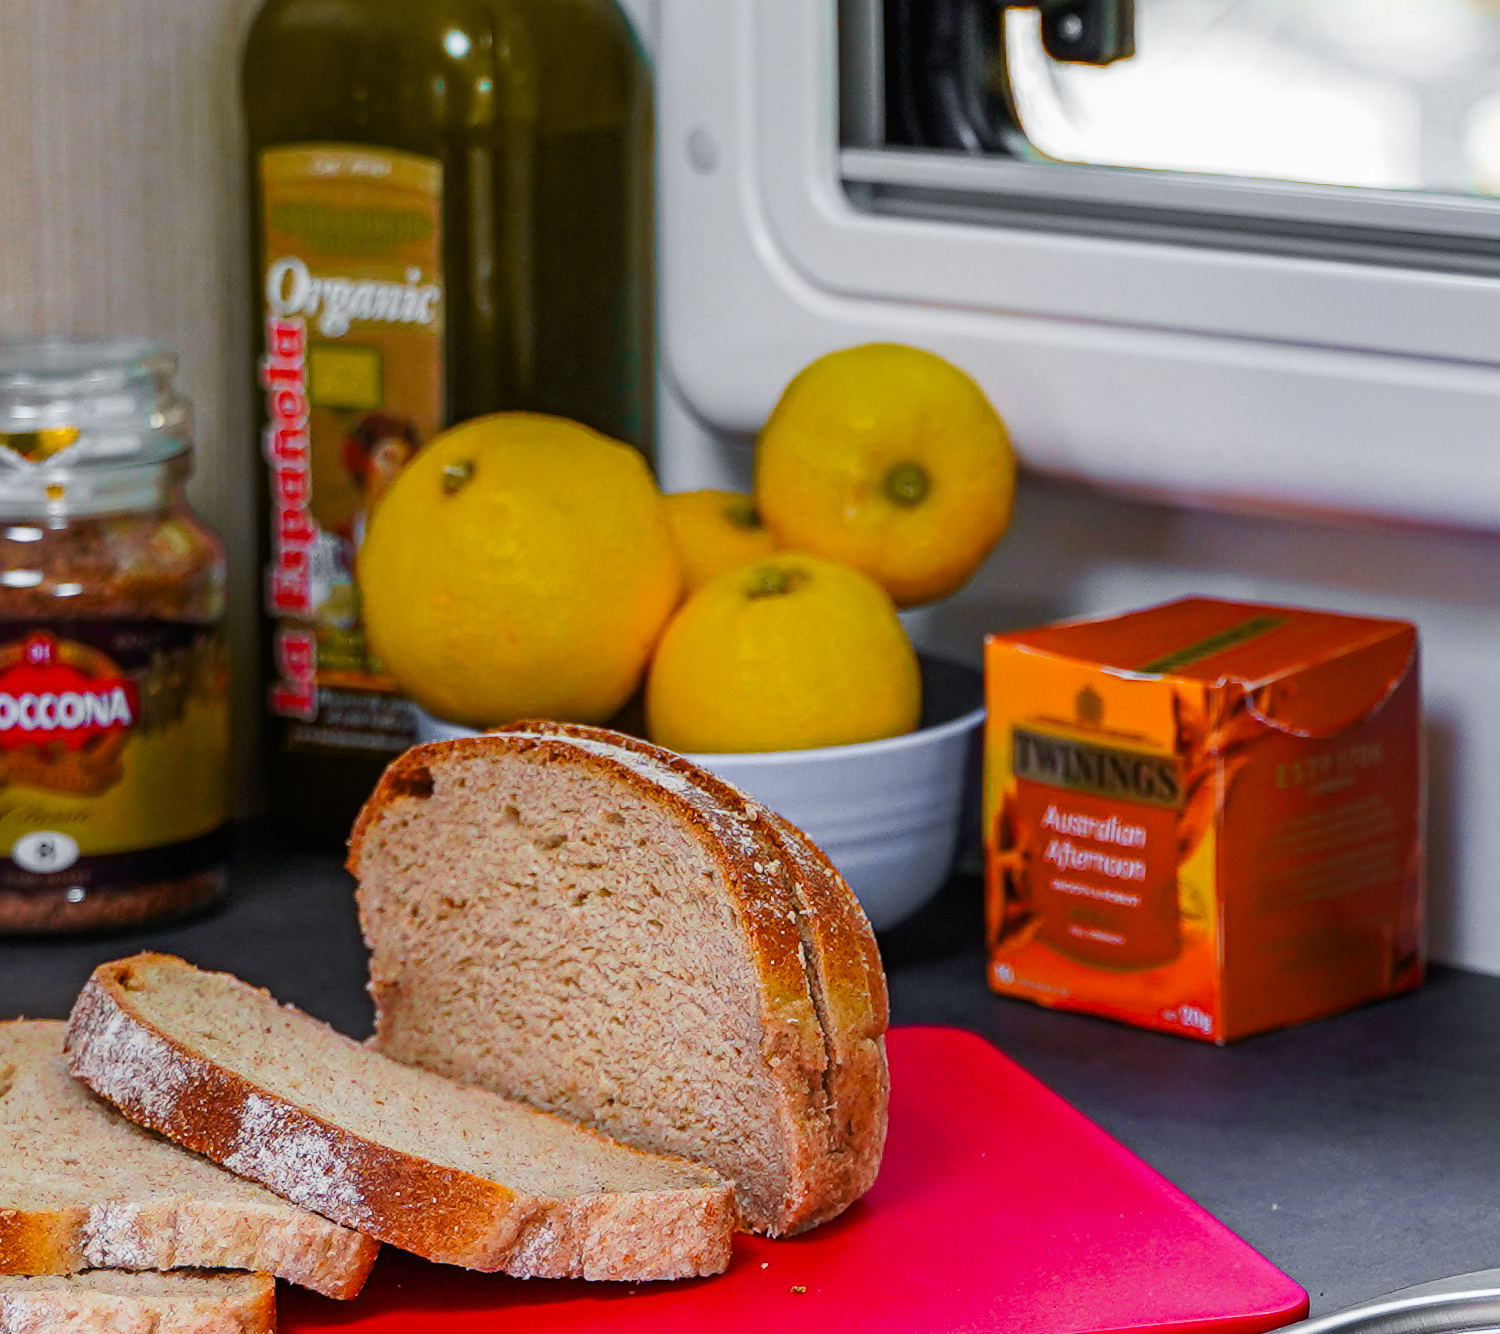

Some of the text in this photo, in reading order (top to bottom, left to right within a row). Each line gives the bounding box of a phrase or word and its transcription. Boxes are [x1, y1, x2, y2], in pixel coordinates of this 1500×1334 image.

[266, 256, 441, 336] Organic
[1015, 730, 1181, 805] TWININGS
[1041, 803, 1147, 849] Australian
[1043, 839, 1147, 882] Afternoon
